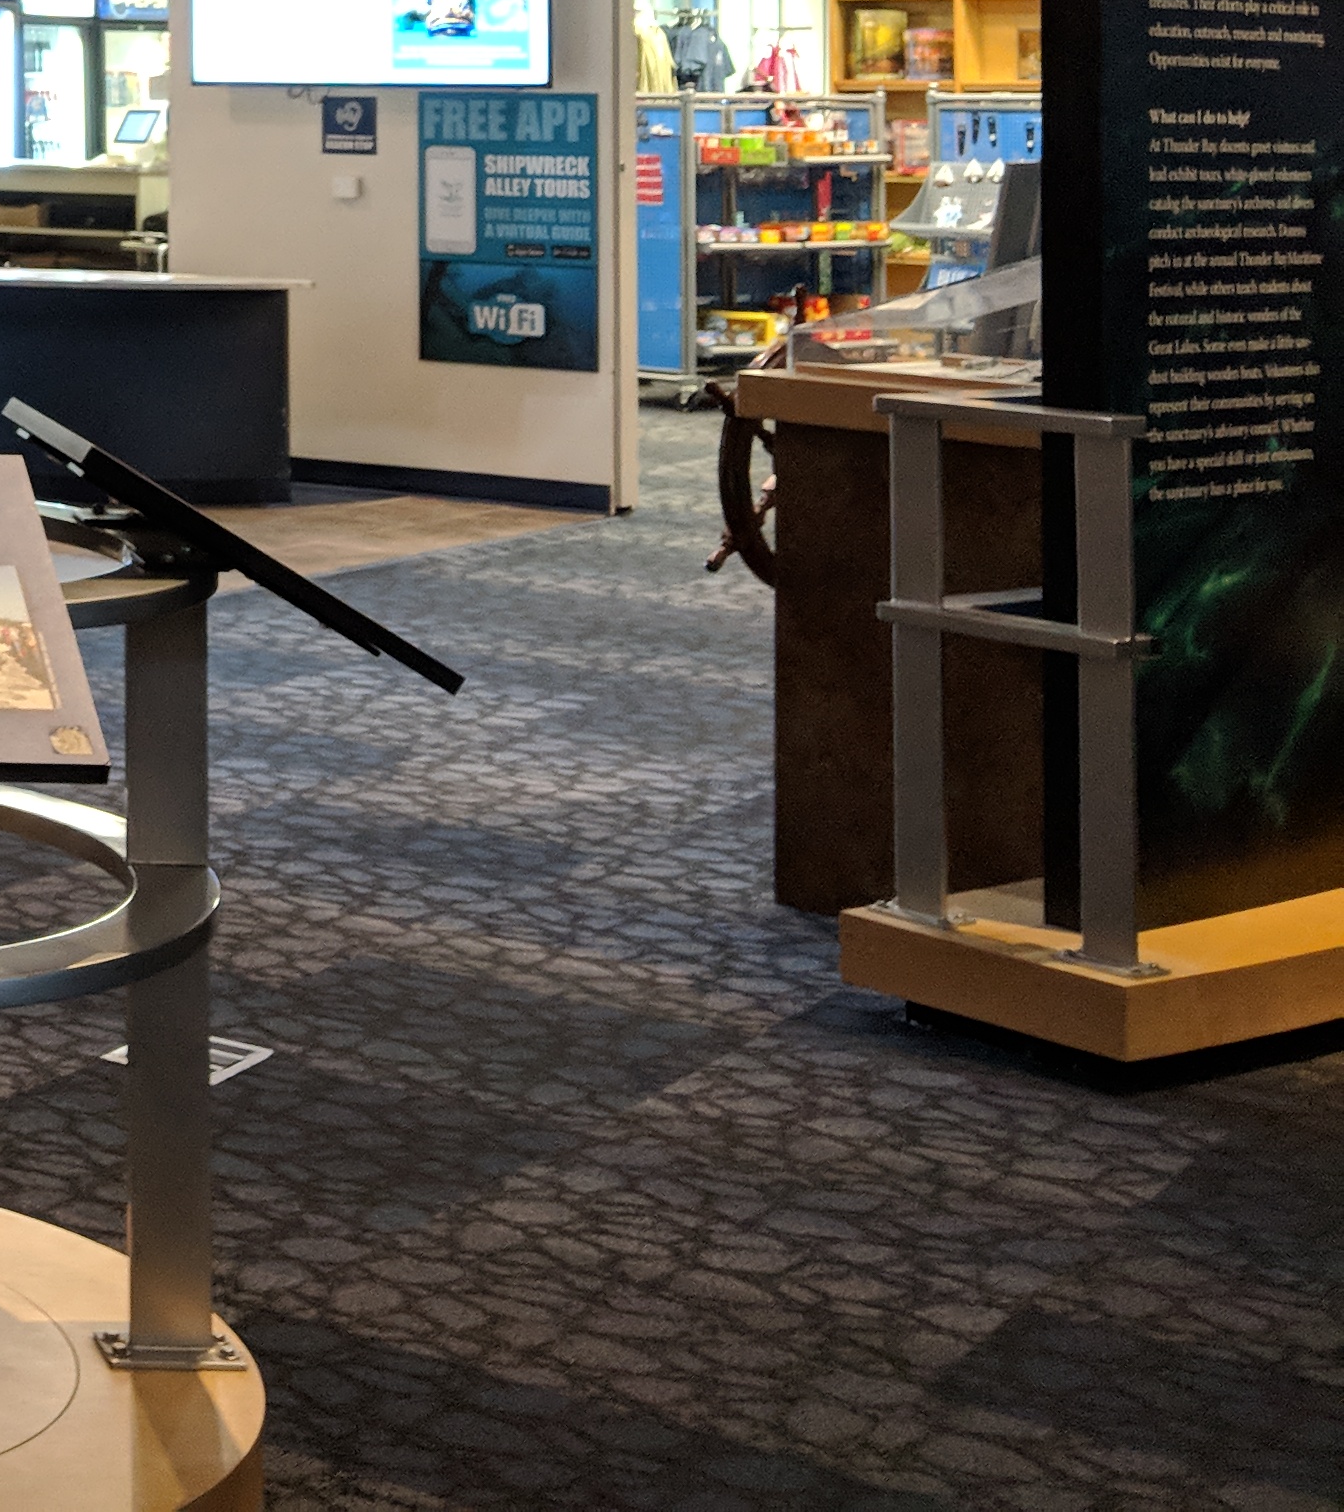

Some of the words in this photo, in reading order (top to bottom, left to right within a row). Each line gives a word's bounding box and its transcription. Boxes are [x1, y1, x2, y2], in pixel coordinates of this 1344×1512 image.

[423, 99, 508, 141] FREE
[514, 100, 591, 143] APP
[484, 154, 591, 176] SHIPWRECK
[484, 177, 532, 197] ALLEY
[533, 178, 591, 199] TOURS
